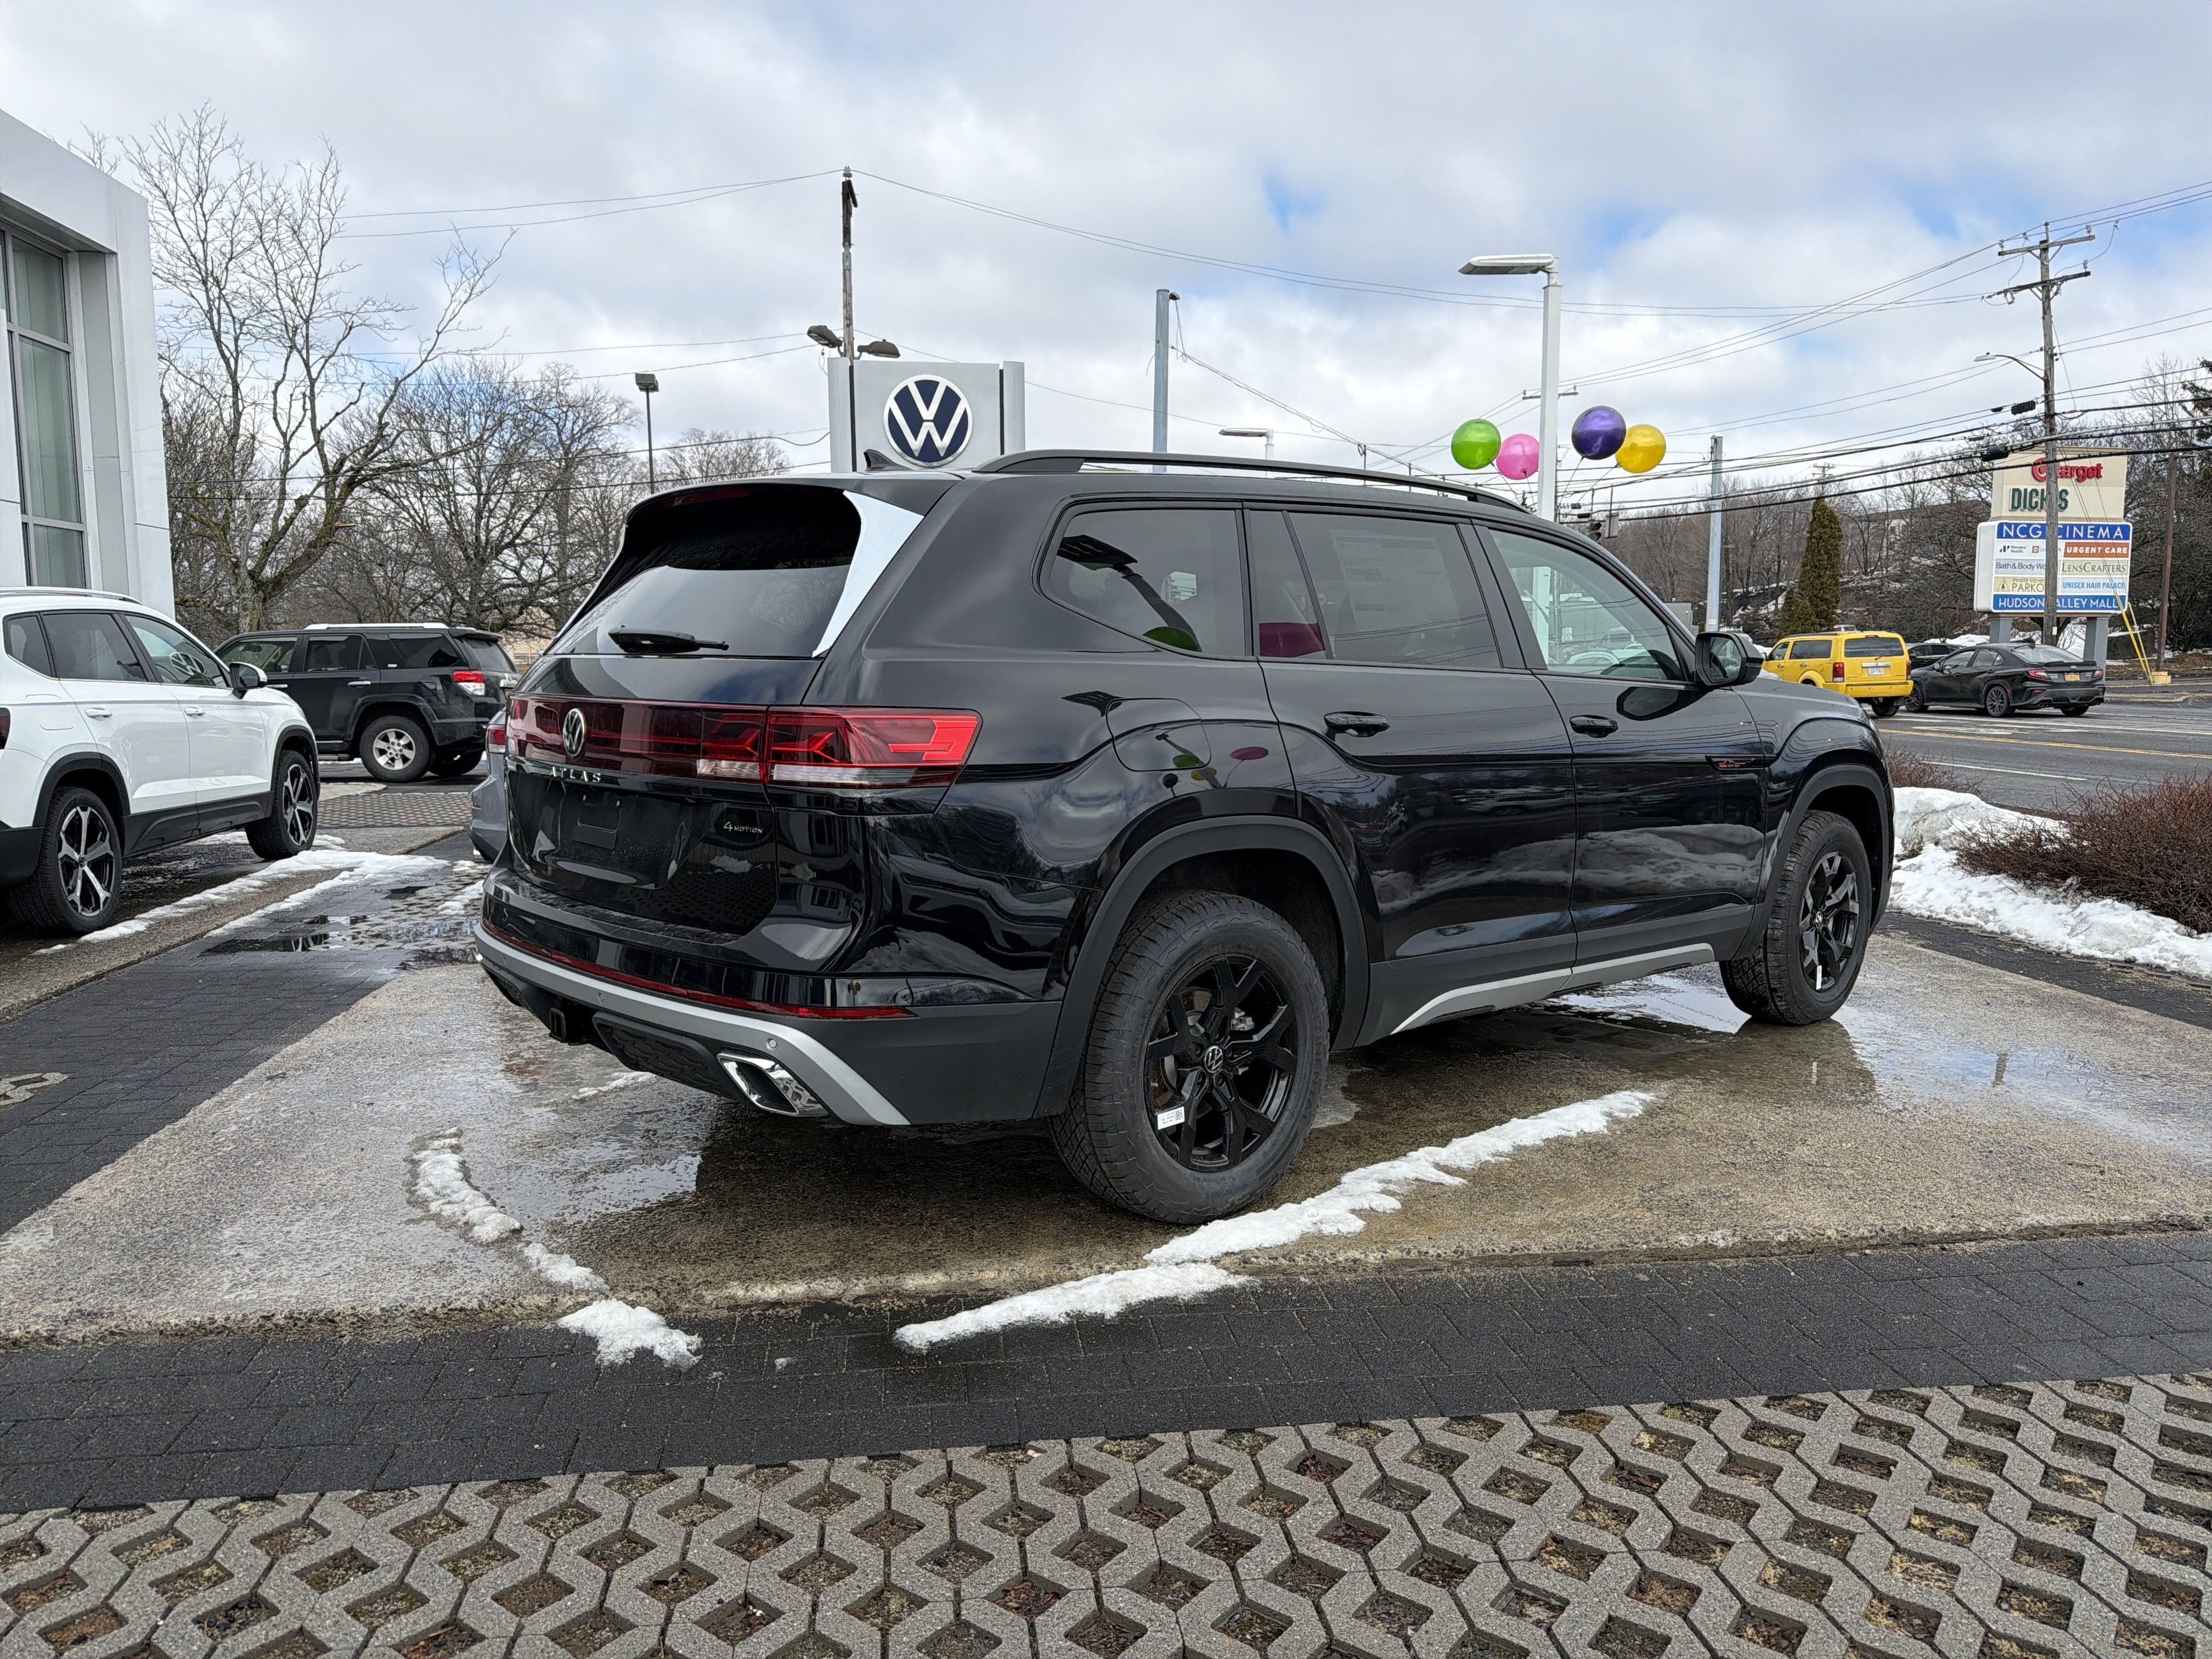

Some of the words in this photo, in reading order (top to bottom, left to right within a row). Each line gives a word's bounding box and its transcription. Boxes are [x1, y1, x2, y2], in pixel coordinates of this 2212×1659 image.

[2057, 464, 2103, 482] arget
[2011, 488, 2069, 510] DICS
[2002, 524, 2042, 538] NCG
[2012, 583, 2044, 592] PARKO
[1999, 597, 2045, 608] HUDSON
[2057, 598, 2087, 608] ALLEY
[2090, 599, 2118, 608] MALL
[550, 766, 601, 782] ATLAS
[723, 822, 763, 833] 4MOTION
